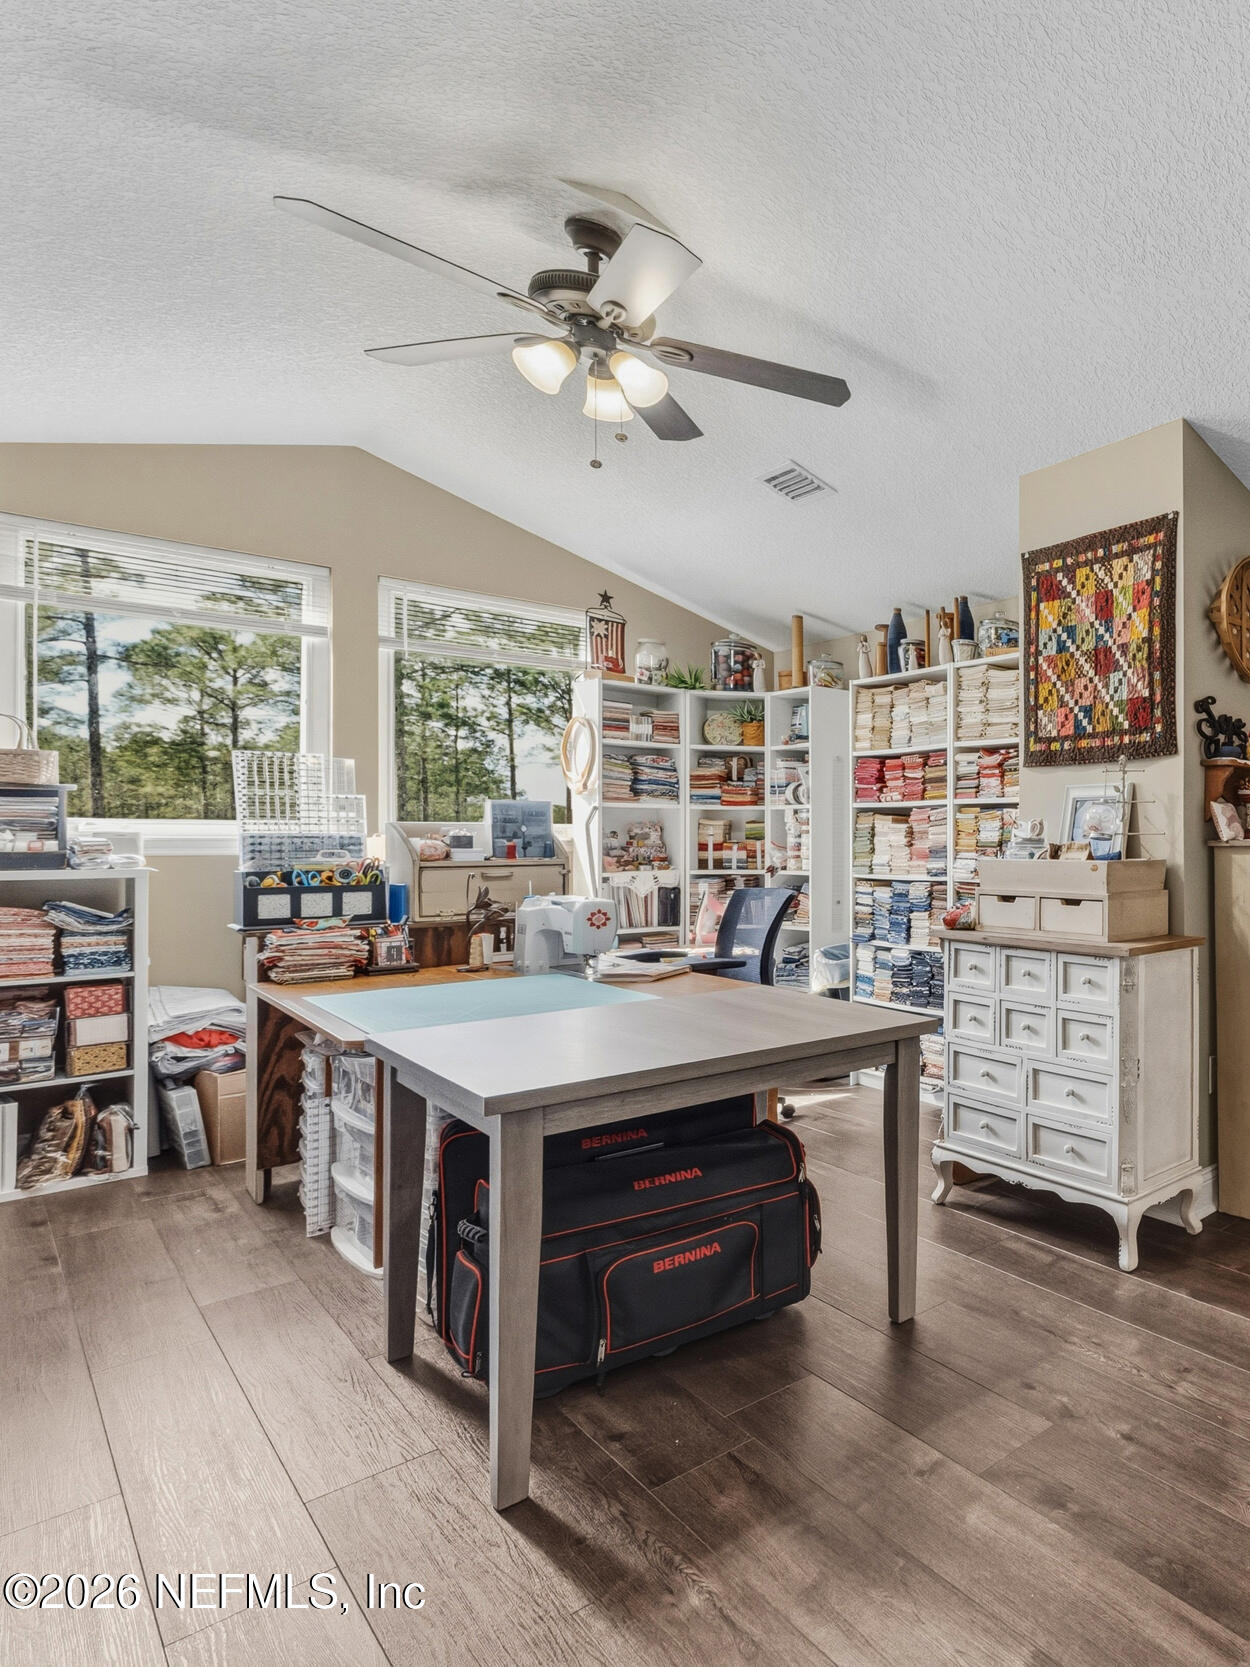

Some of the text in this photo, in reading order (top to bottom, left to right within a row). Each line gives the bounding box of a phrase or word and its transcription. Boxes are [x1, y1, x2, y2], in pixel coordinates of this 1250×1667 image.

[581, 1128, 648, 1149] BERNINA
[633, 1167, 703, 1191] BERNINA
[653, 1242, 721, 1274] BERNINA
